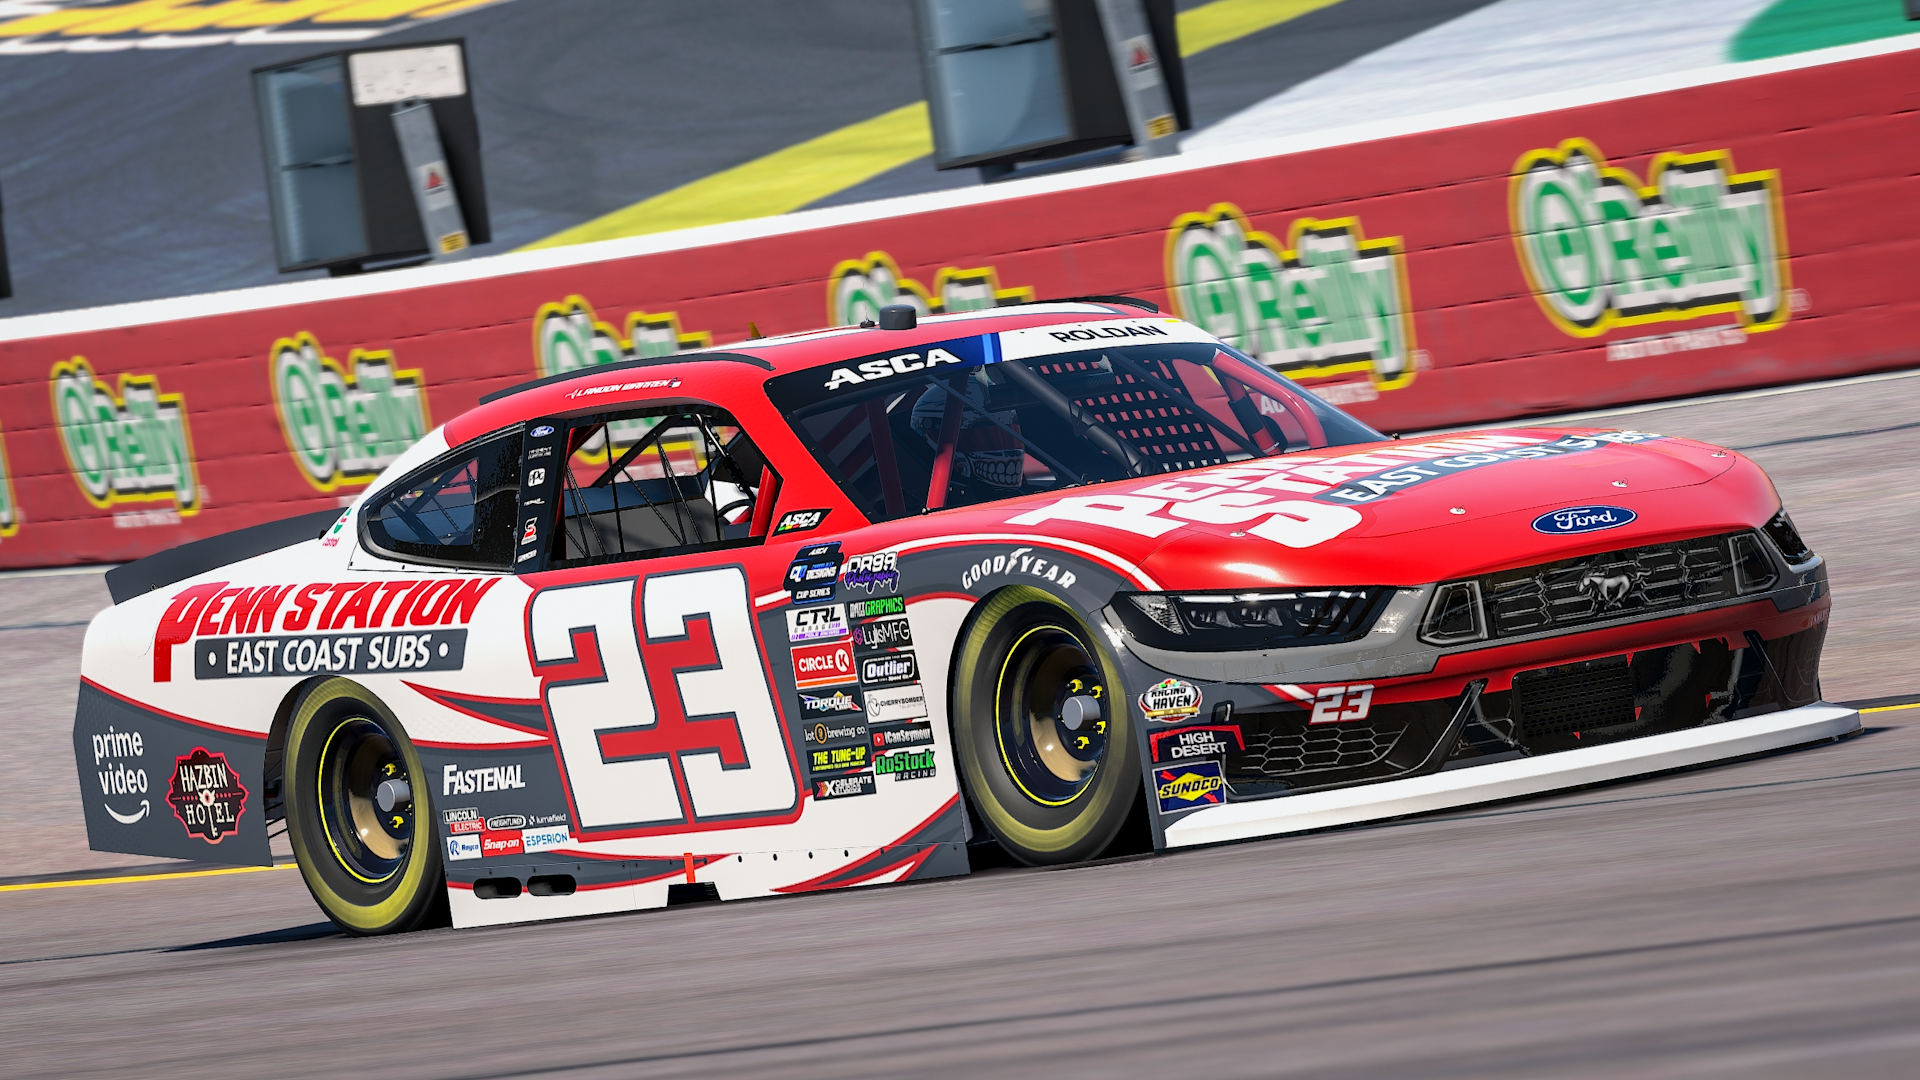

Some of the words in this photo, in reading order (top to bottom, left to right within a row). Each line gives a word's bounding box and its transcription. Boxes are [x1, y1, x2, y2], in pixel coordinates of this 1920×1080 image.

[1048, 323, 1169, 343] ROLDAN
[823, 347, 962, 391] ASCA
[576, 384, 622, 397] LANDON
[621, 379, 671, 391] WARREN
[1168, 435, 1549, 549] STATION
[1330, 465, 1442, 502] EAST
[779, 511, 822, 528] ASCA
[1549, 508, 1621, 531] Ford
[806, 566, 838, 581] DESIGNS
[961, 548, 1077, 590] GOODYEAR
[795, 590, 809, 600] CUP
[808, 587, 831, 598] SERIES
[796, 606, 841, 626] CTRL
[865, 597, 904, 616] GRAPHICS
[153, 580, 298, 682] PENN
[283, 577, 502, 631] STATION
[225, 640, 280, 674] EAST
[282, 637, 363, 673] COAST
[366, 634, 433, 670] SUBS
[798, 655, 834, 673] CIRCLE
[837, 652, 849, 671] K
[866, 660, 911, 678] Outlier
[529, 565, 798, 829] 23
[804, 695, 853, 710] TORQUE
[1153, 694, 1191, 710] HAVEN
[1309, 683, 1375, 724] 23
[804, 728, 815, 742] lot
[826, 726, 855, 740] brewing
[1178, 731, 1215, 746] HIGH
[92, 725, 144, 765] prime
[1170, 741, 1227, 759] DESERT
[812, 750, 829, 766] THE
[831, 746, 866, 763] TUNE-UP
[875, 749, 936, 775] RoStock
[98, 762, 149, 795] video
[179, 763, 229, 793] HAZBIN
[443, 764, 526, 796] FASTENAL
[896, 769, 937, 781] RACING
[1161, 777, 1221, 797] SUNOCO
[185, 800, 236, 830] HOTEL
[445, 809, 478, 822] LINCOLN
[490, 817, 523, 828] FREIGHTLINER
[536, 813, 567, 825] lumafield
[453, 821, 483, 832] ELECTRIC
[483, 838, 520, 851] Snap-on
[525, 832, 568, 847] ESPERION
